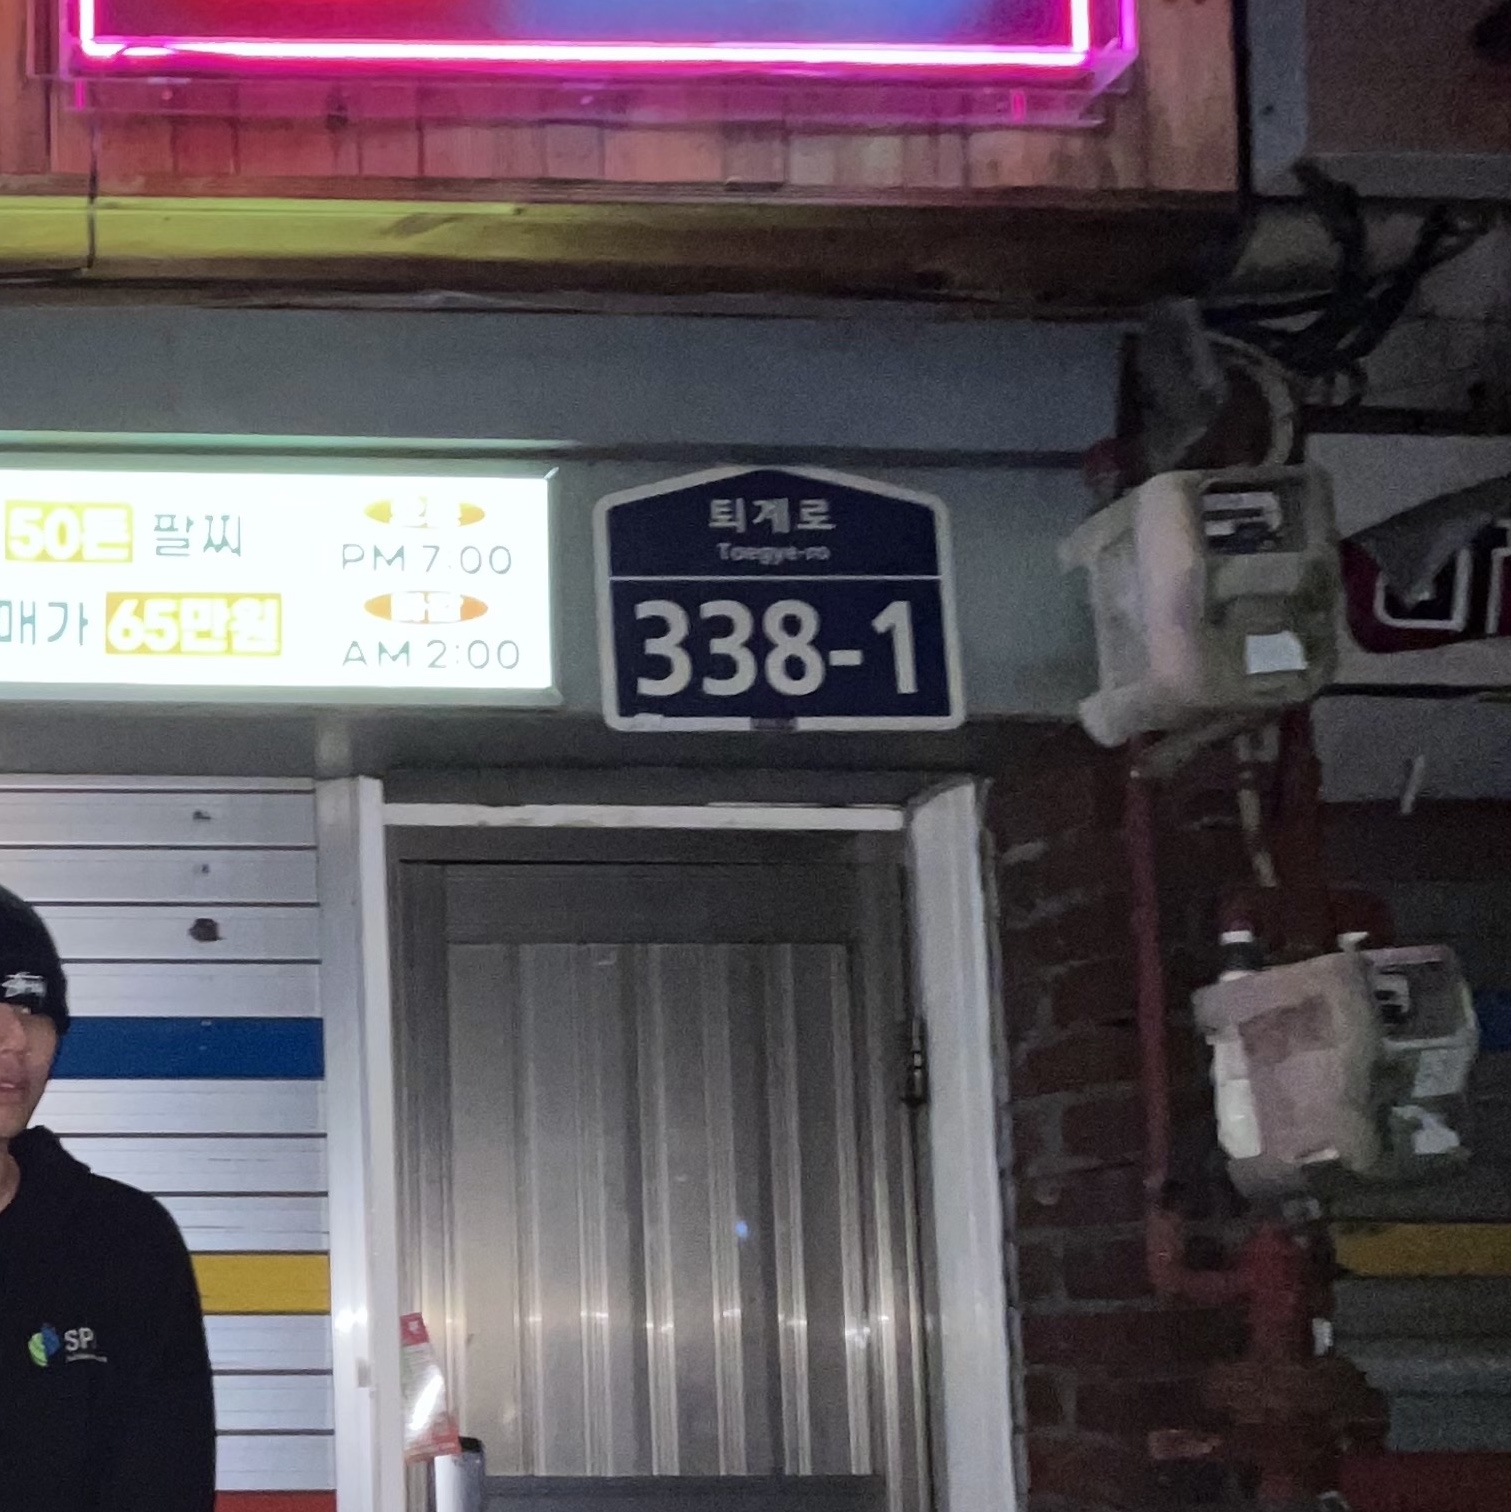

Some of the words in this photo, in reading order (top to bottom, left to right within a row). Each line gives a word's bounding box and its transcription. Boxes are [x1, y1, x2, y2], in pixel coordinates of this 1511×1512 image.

[708, 496, 836, 534] 퇴계로
[341, 542, 405, 571] PM
[341, 639, 411, 667] AM
[426, 638, 520, 670] 2:00
[634, 598, 919, 697] 338-1
